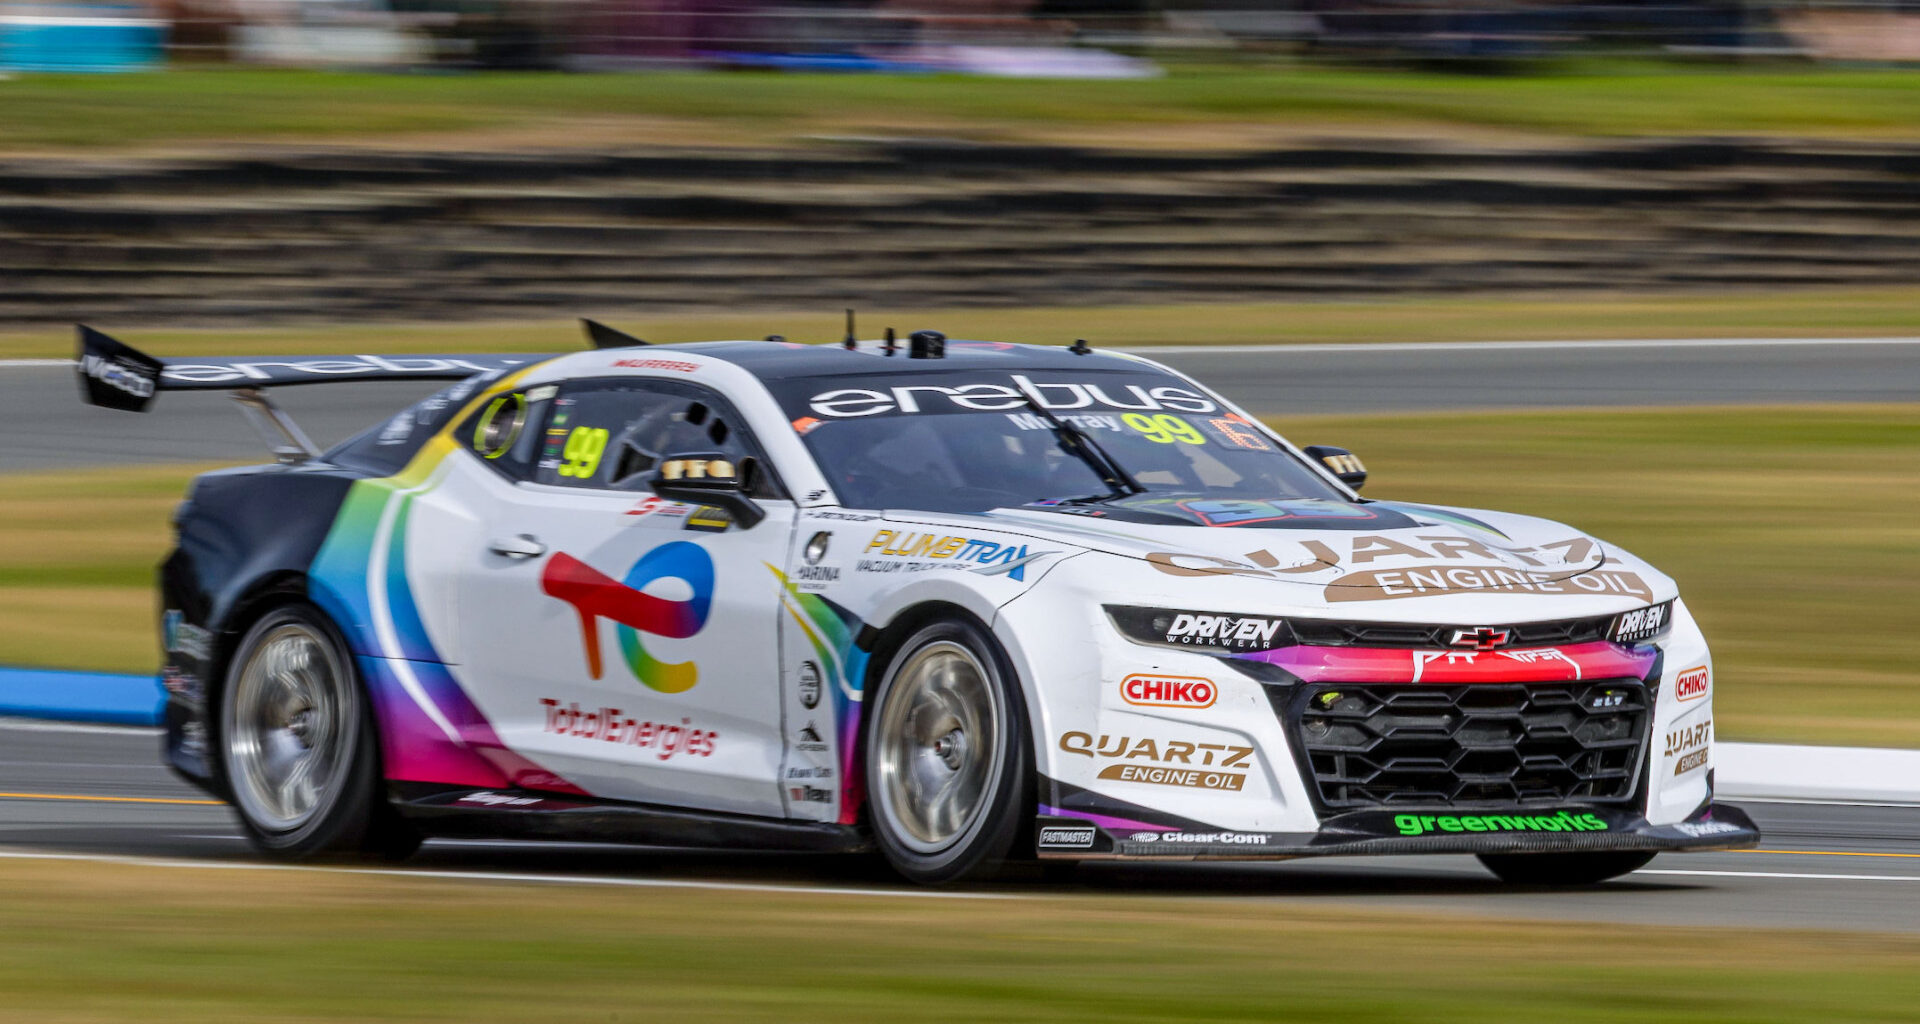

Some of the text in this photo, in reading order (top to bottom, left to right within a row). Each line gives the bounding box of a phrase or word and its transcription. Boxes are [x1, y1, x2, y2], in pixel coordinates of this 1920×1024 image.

[809, 375, 1217, 417] erebus
[1120, 412, 1206, 445] 99
[558, 426, 609, 479] 99
[863, 529, 1030, 583] PLUMBTRAX
[1374, 568, 1646, 595] ENGINE OIL
[1166, 613, 1283, 641] DRIVEN
[1617, 604, 1666, 636] DRIVEN
[1165, 635, 1271, 649] WORKWEAR
[1615, 626, 1661, 643] WORKWEAR
[1126, 679, 1212, 704] CHIKO
[1677, 671, 1708, 697] CHIKO
[539, 698, 719, 761] TotalEnergies
[1058, 731, 1255, 769] QUARTZ
[1120, 766, 1238, 790] ENGINE OIL
[1394, 810, 1609, 836] greenworks
[1042, 831, 1092, 844] FASTMASTER
[1161, 832, 1269, 845] Clear-Com
